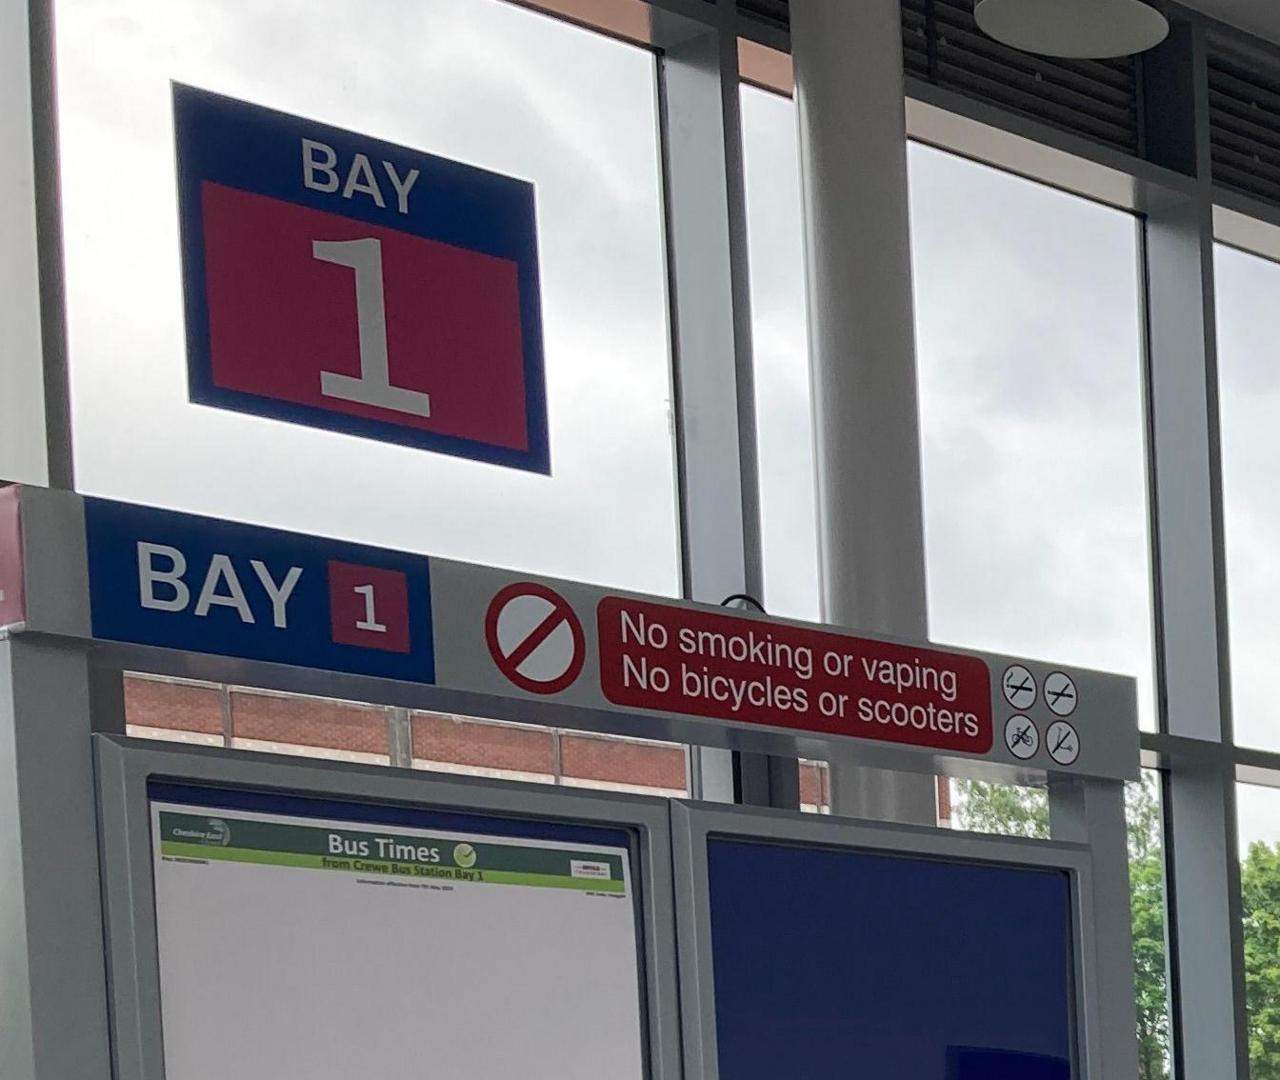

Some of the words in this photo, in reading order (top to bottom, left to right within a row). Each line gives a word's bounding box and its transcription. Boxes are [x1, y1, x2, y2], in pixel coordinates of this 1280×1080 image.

[302, 137, 420, 215] BAY
[311, 236, 431, 418] 1
[136, 540, 303, 629] BAY
[352, 583, 387, 633] 1
[620, 609, 668, 651] No
[678, 625, 813, 682] smoking
[823, 652, 854, 678] or
[860, 655, 958, 703] vaping
[621, 656, 671, 694] No
[681, 669, 809, 713] bicycles
[818, 691, 848, 718] or
[858, 696, 980, 738] scooters
[322, 857, 351, 870] from
[353, 861, 389, 874] Crewe
[391, 863, 412, 874] Bus
[414, 865, 452, 879] Station
[454, 868, 474, 882] Bay
[476, 871, 483, 881] 1
[328, 834, 370, 856] Bus
[374, 838, 441, 863] Times
